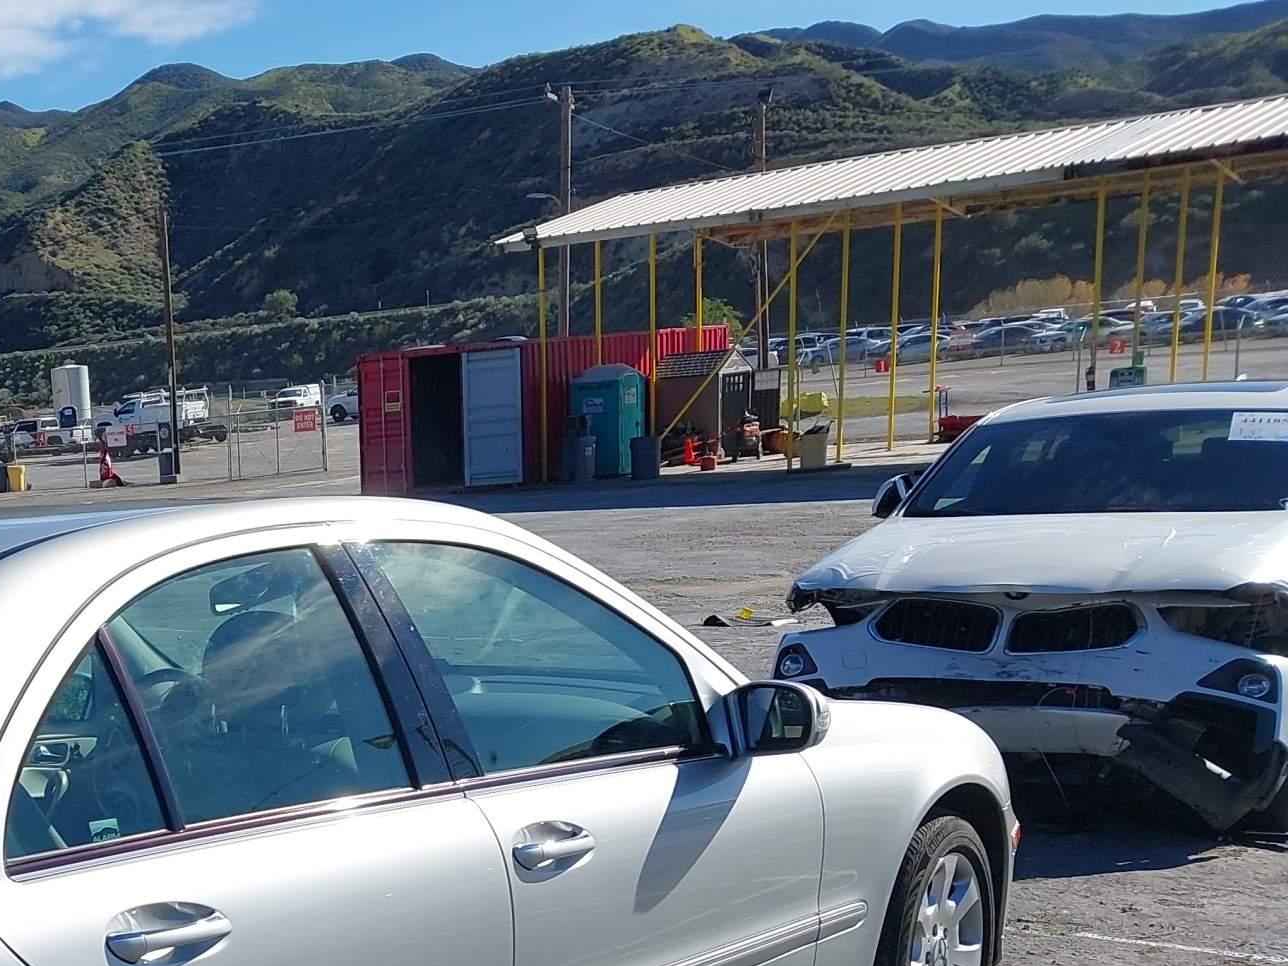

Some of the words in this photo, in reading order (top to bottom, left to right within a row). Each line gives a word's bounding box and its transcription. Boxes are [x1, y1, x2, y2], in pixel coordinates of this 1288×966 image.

[1114, 340, 1121, 352] 2
[296, 414, 303, 422] DO
[304, 413, 315, 421] NOT
[296, 421, 314, 429] ENTER
